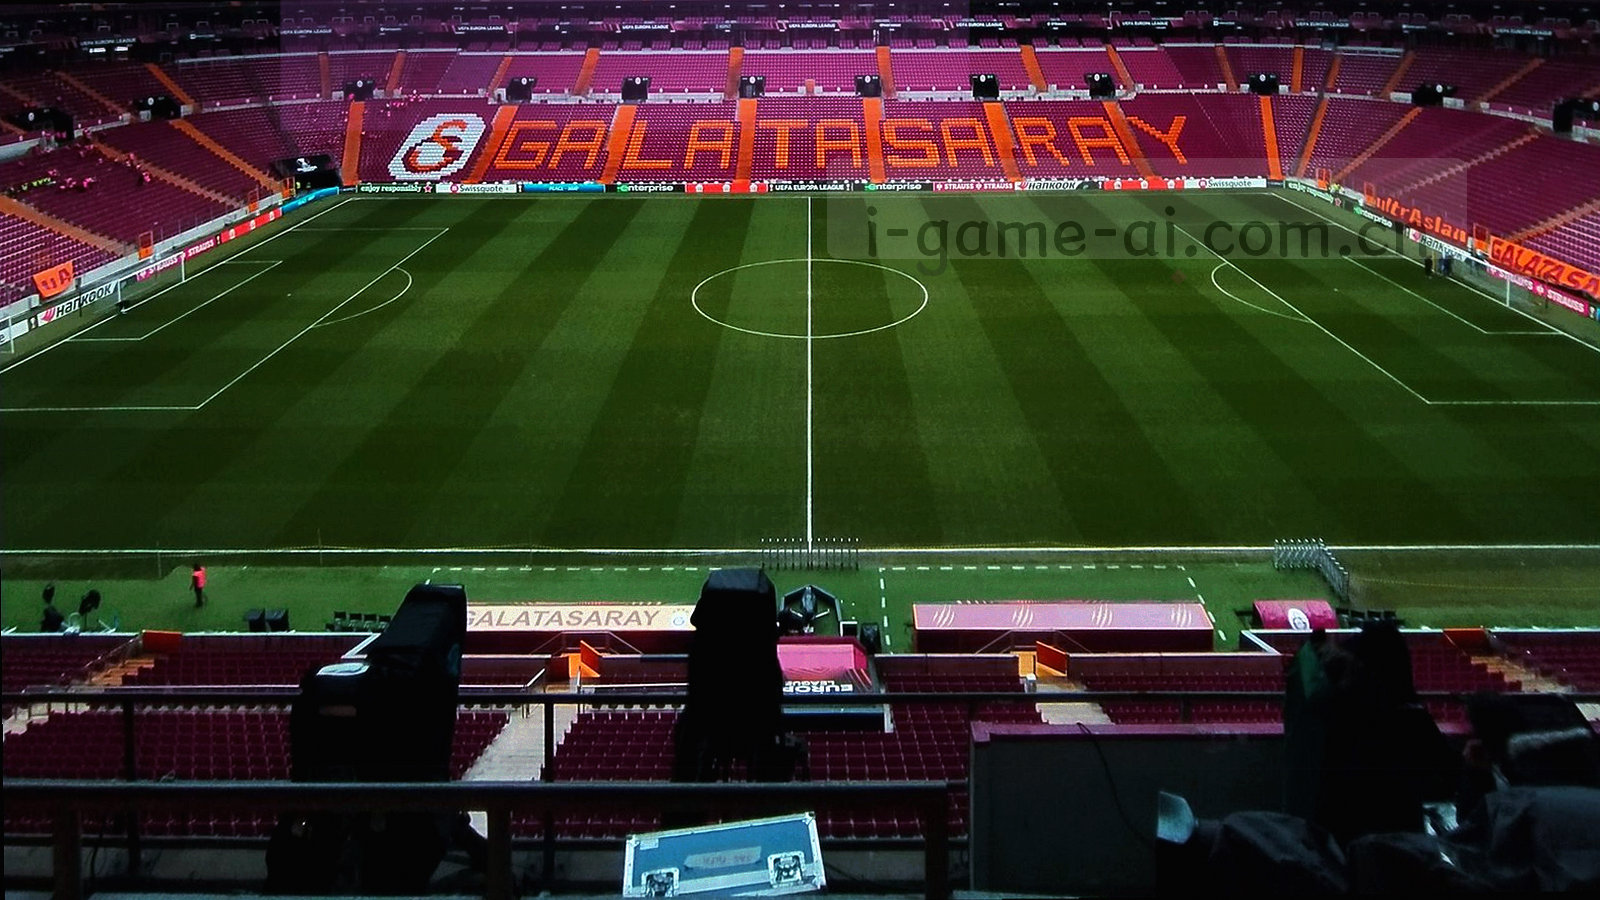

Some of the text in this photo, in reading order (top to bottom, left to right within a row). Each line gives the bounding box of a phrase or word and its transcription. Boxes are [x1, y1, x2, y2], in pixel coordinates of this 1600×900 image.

[494, 116, 1188, 170] GALATASARAY
[1208, 179, 1251, 188] Swissquote
[361, 184, 421, 193] enjoy responsibly
[460, 184, 503, 193] Swissquote
[782, 683, 853, 693] EUROP
